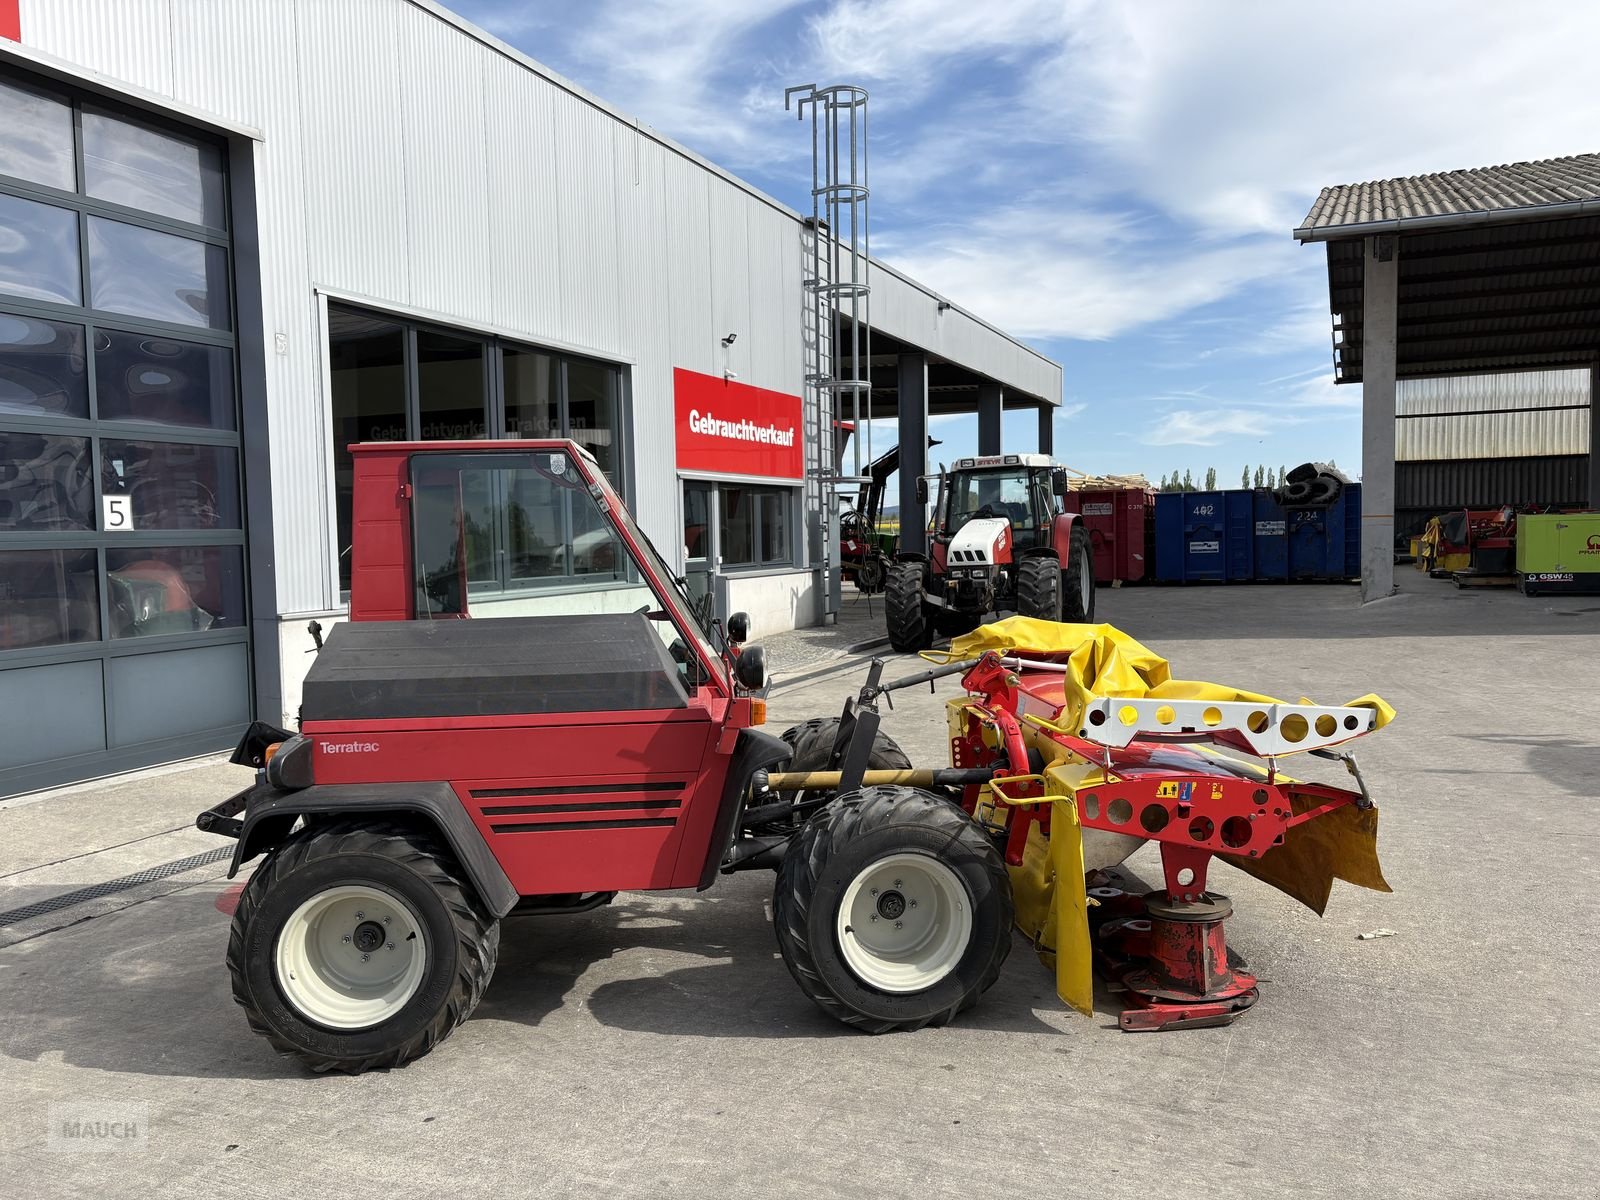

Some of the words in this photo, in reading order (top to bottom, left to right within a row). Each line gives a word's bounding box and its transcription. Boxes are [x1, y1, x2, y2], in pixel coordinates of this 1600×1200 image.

[507, 416, 587, 433] Traktoen
[689, 409, 794, 447] Gebrauchtverkauf
[109, 500, 125, 527] 5
[320, 741, 380, 754] Terratrac
